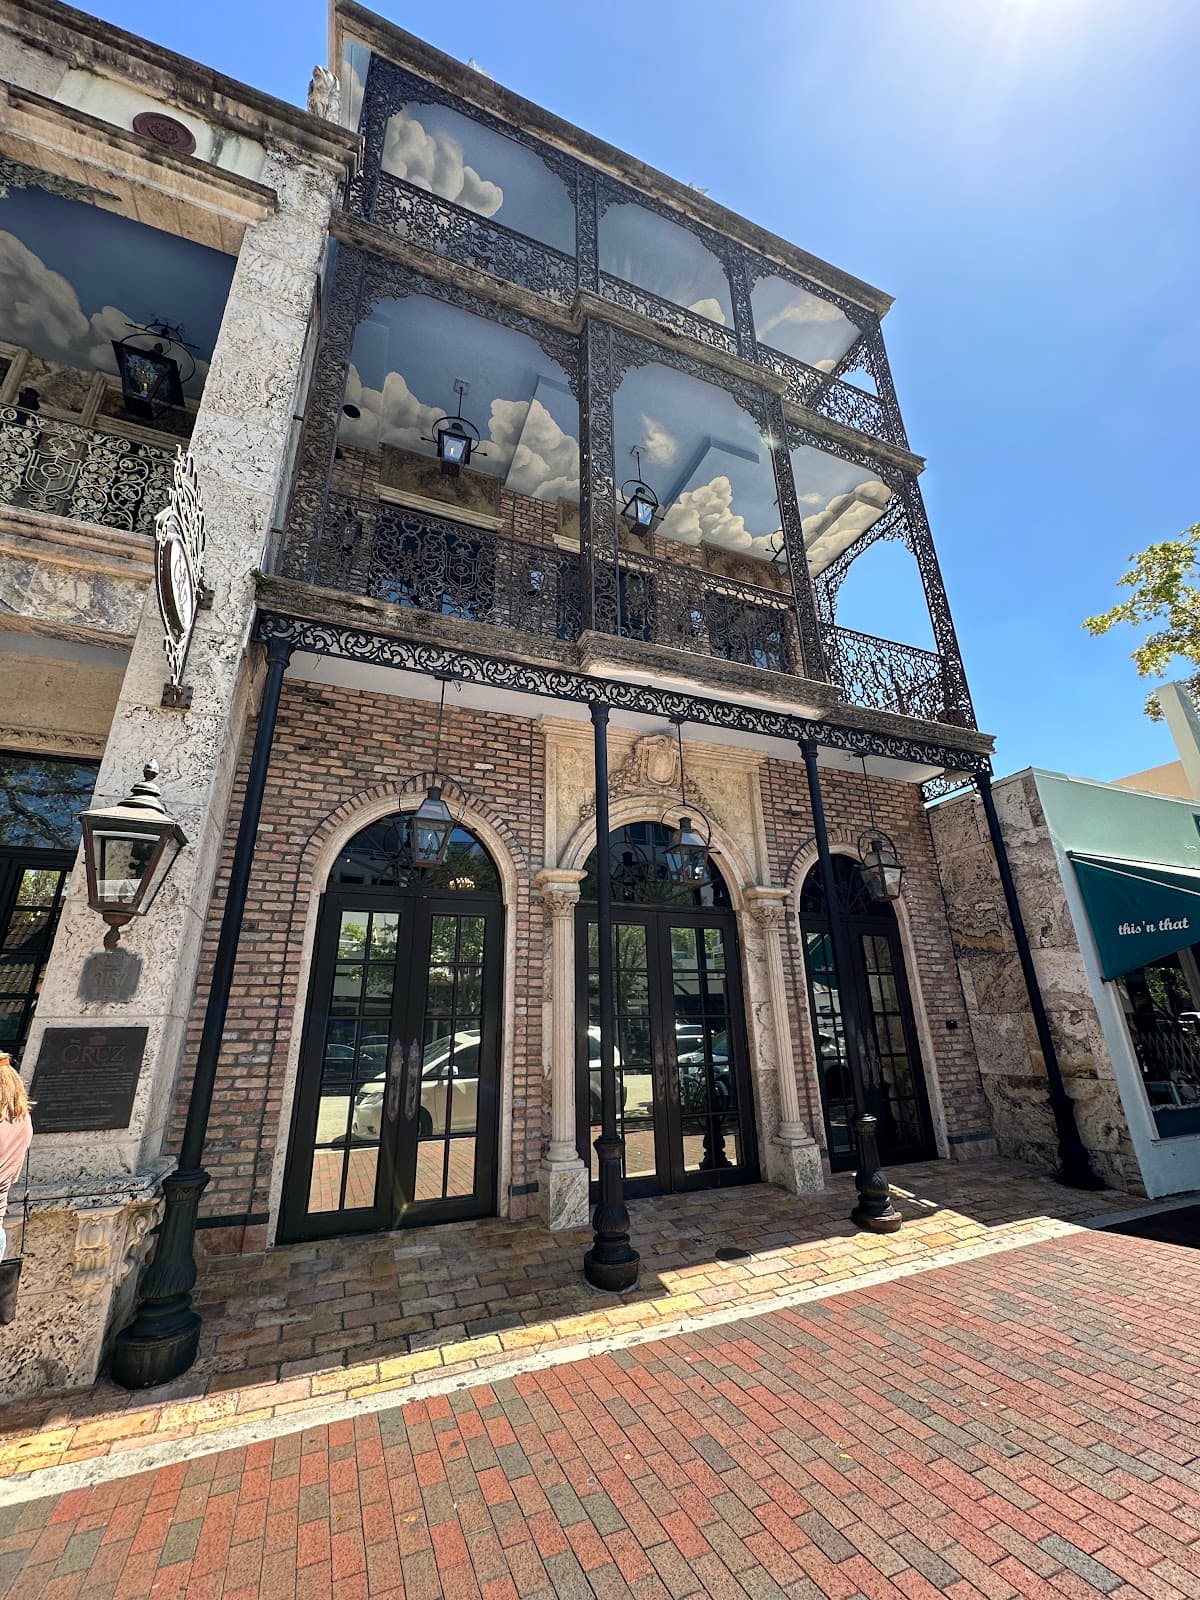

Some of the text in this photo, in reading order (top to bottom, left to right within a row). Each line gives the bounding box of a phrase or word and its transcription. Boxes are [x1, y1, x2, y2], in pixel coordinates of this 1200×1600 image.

[1118, 918, 1189, 935] this'n that
[62, 1044, 127, 1066] CRUZ
